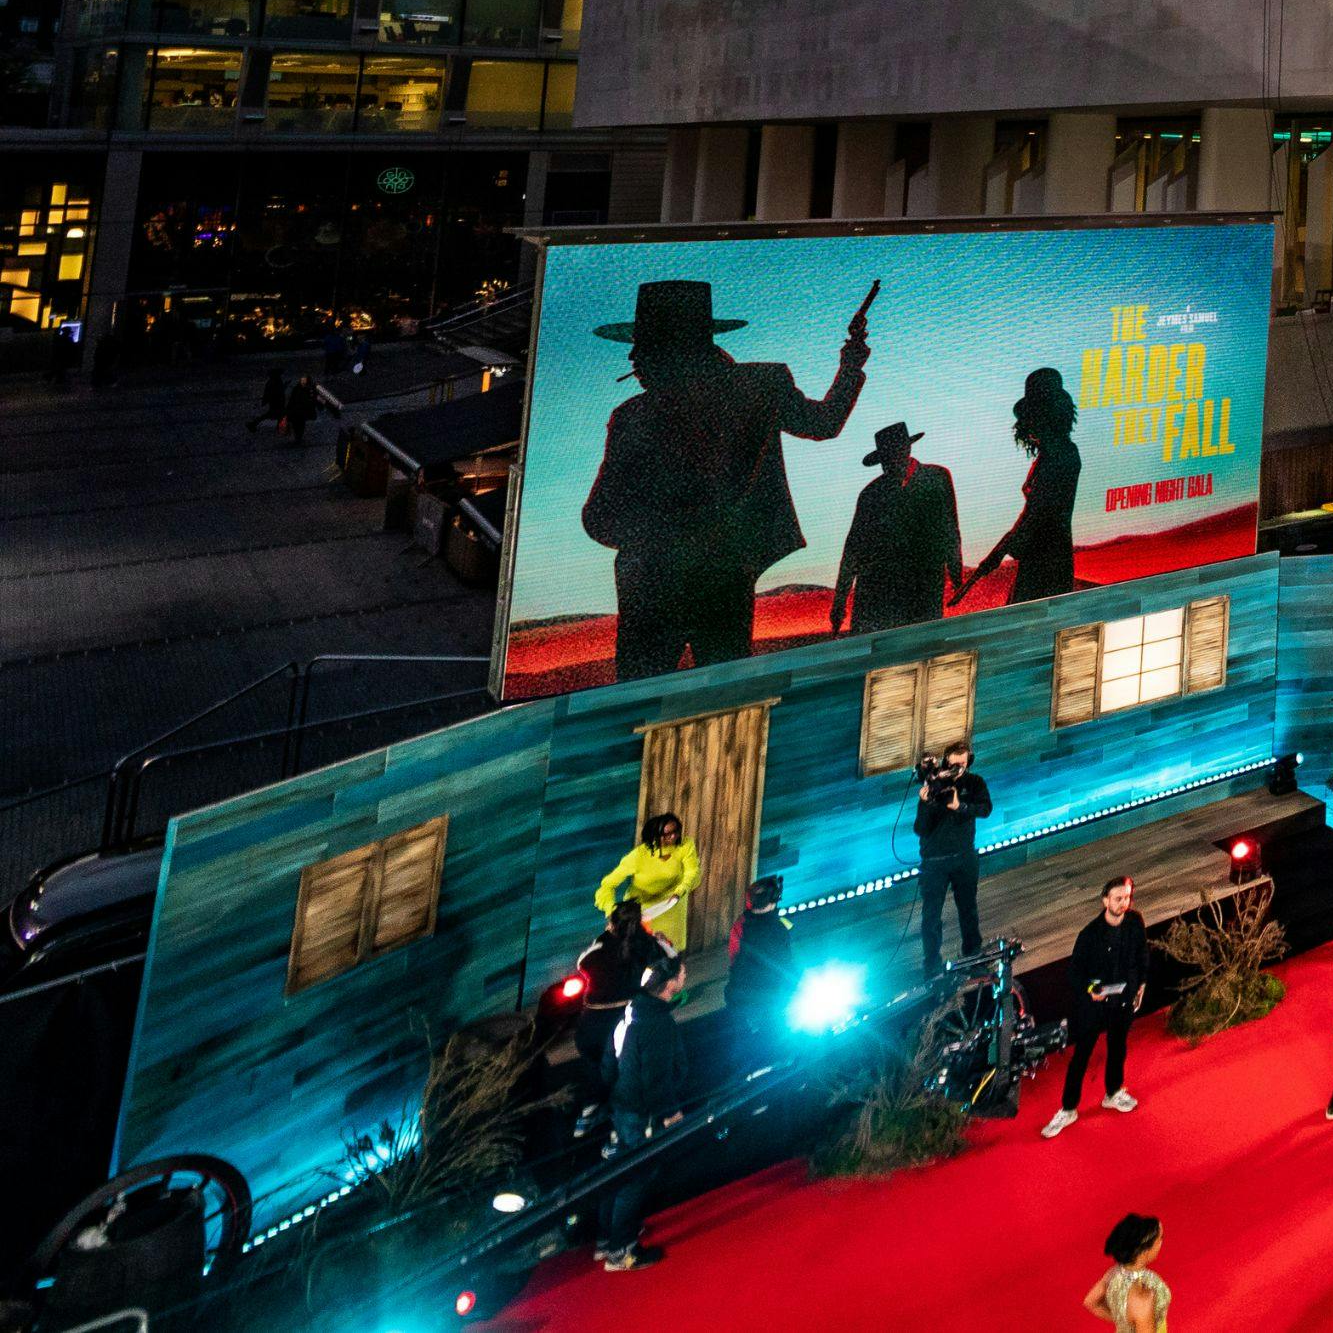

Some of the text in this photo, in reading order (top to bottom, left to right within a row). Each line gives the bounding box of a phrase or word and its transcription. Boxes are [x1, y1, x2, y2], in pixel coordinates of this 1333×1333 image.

[1110, 304, 1149, 342] THE
[1189, 311, 1218, 324] SAMUEL
[1079, 343, 1207, 409] HARDER
[1113, 397, 1235, 463] THEY FALL
[1105, 473, 1213, 513] OPENING NIGHT GALA
